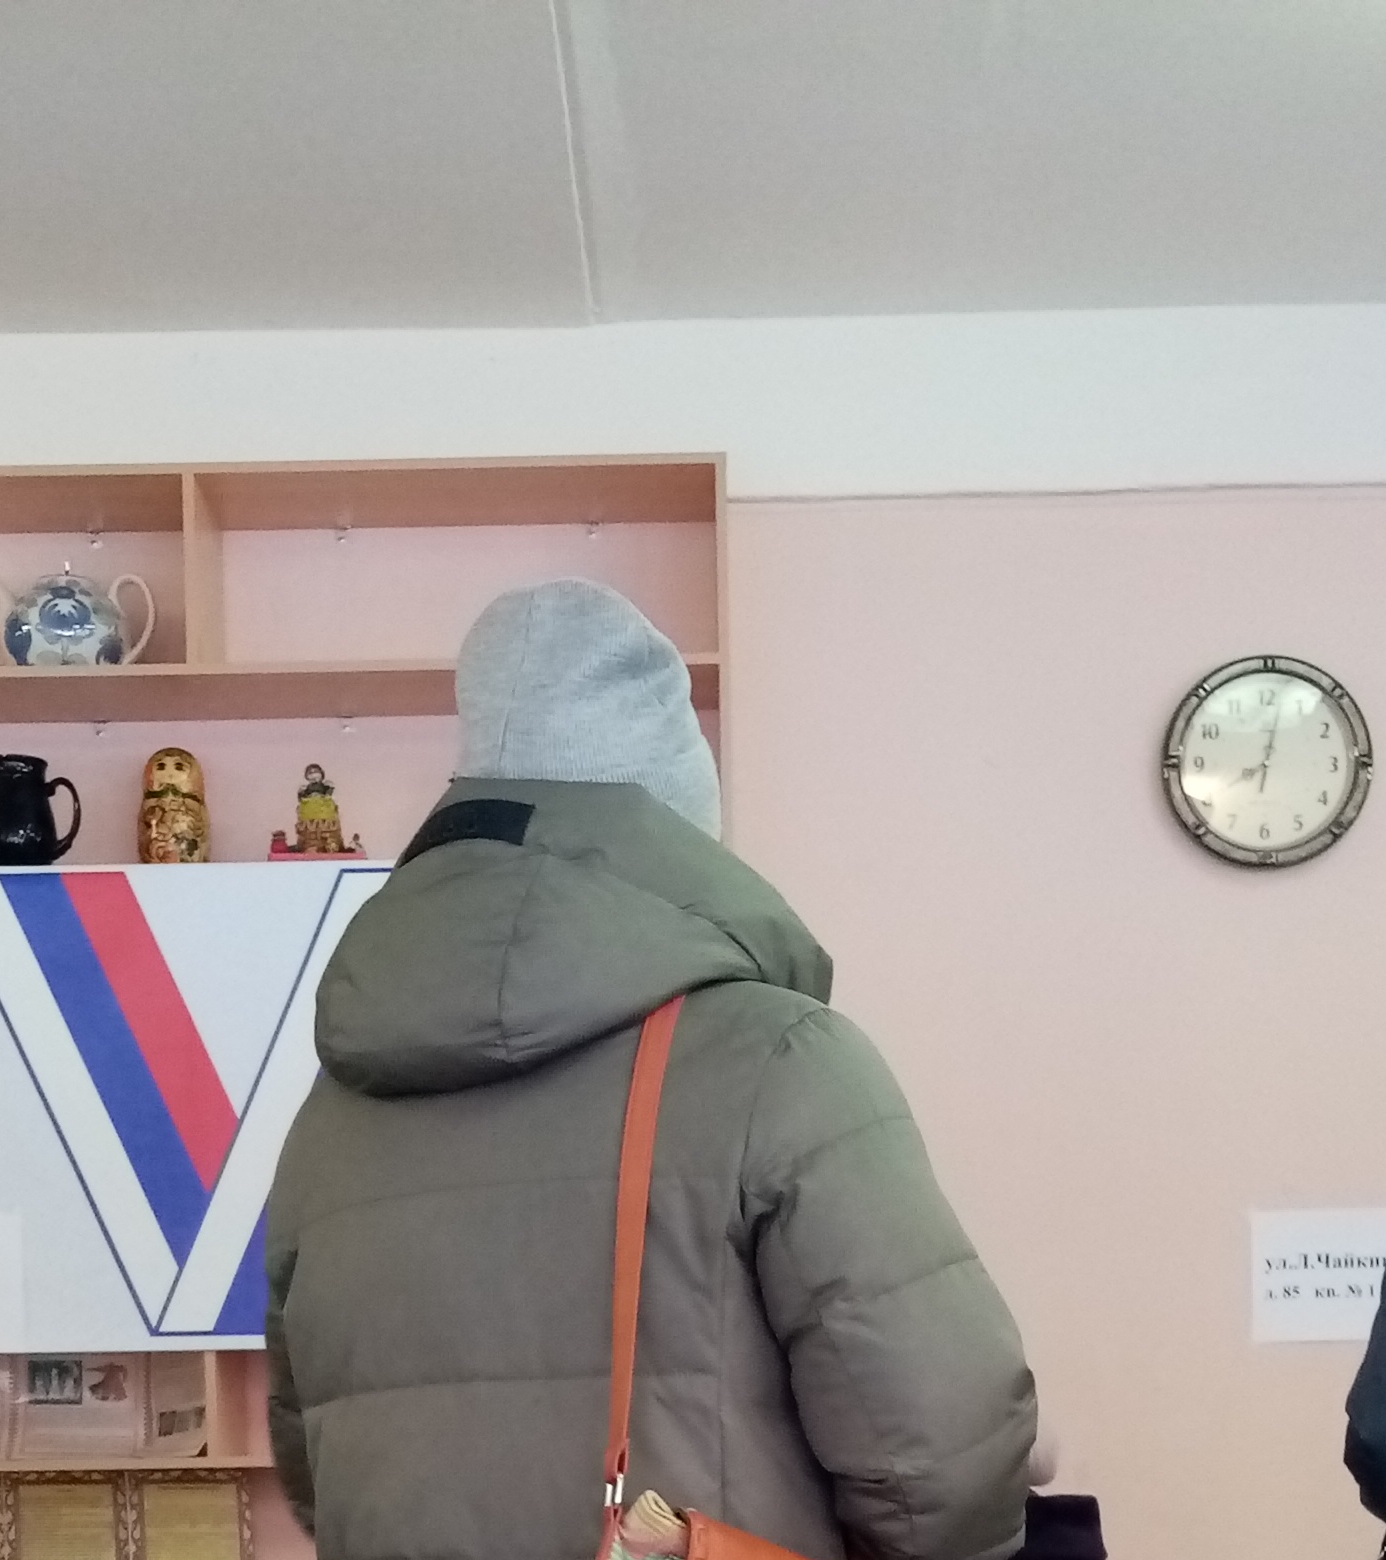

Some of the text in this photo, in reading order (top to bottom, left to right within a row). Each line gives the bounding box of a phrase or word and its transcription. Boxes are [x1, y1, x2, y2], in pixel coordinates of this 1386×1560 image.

[1201, 723, 1219, 740] 10
[1320, 722, 1330, 739] 2
[1194, 756, 1205, 772] 9
[1329, 756, 1339, 772] 3
[1317, 790, 1328, 806] 4
[1293, 814, 1303, 831] 5
[1259, 823, 1270, 840] 6
